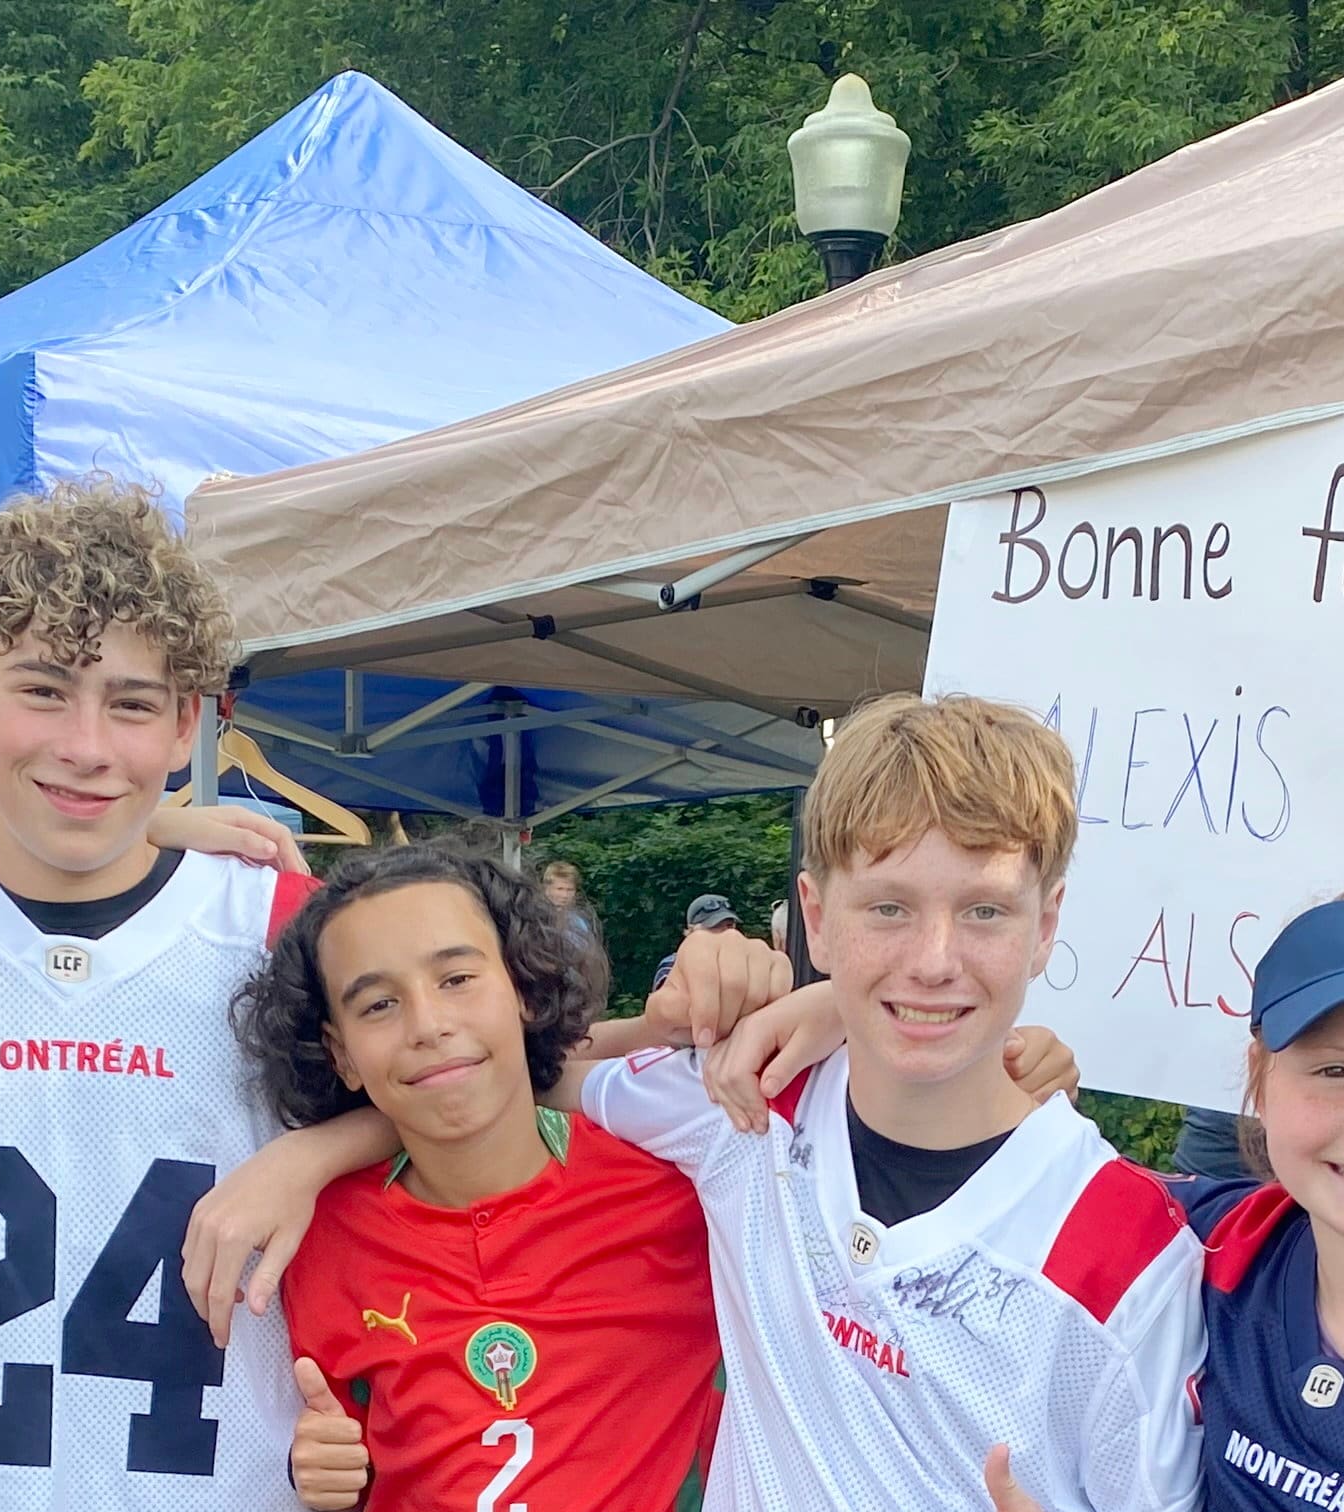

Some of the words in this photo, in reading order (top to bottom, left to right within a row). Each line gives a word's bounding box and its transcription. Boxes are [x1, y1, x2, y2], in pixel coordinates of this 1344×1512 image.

[991, 485, 1233, 605] Bonne
[52, 953, 83, 972] LCF
[1309, 1374, 1334, 1398] LCF
